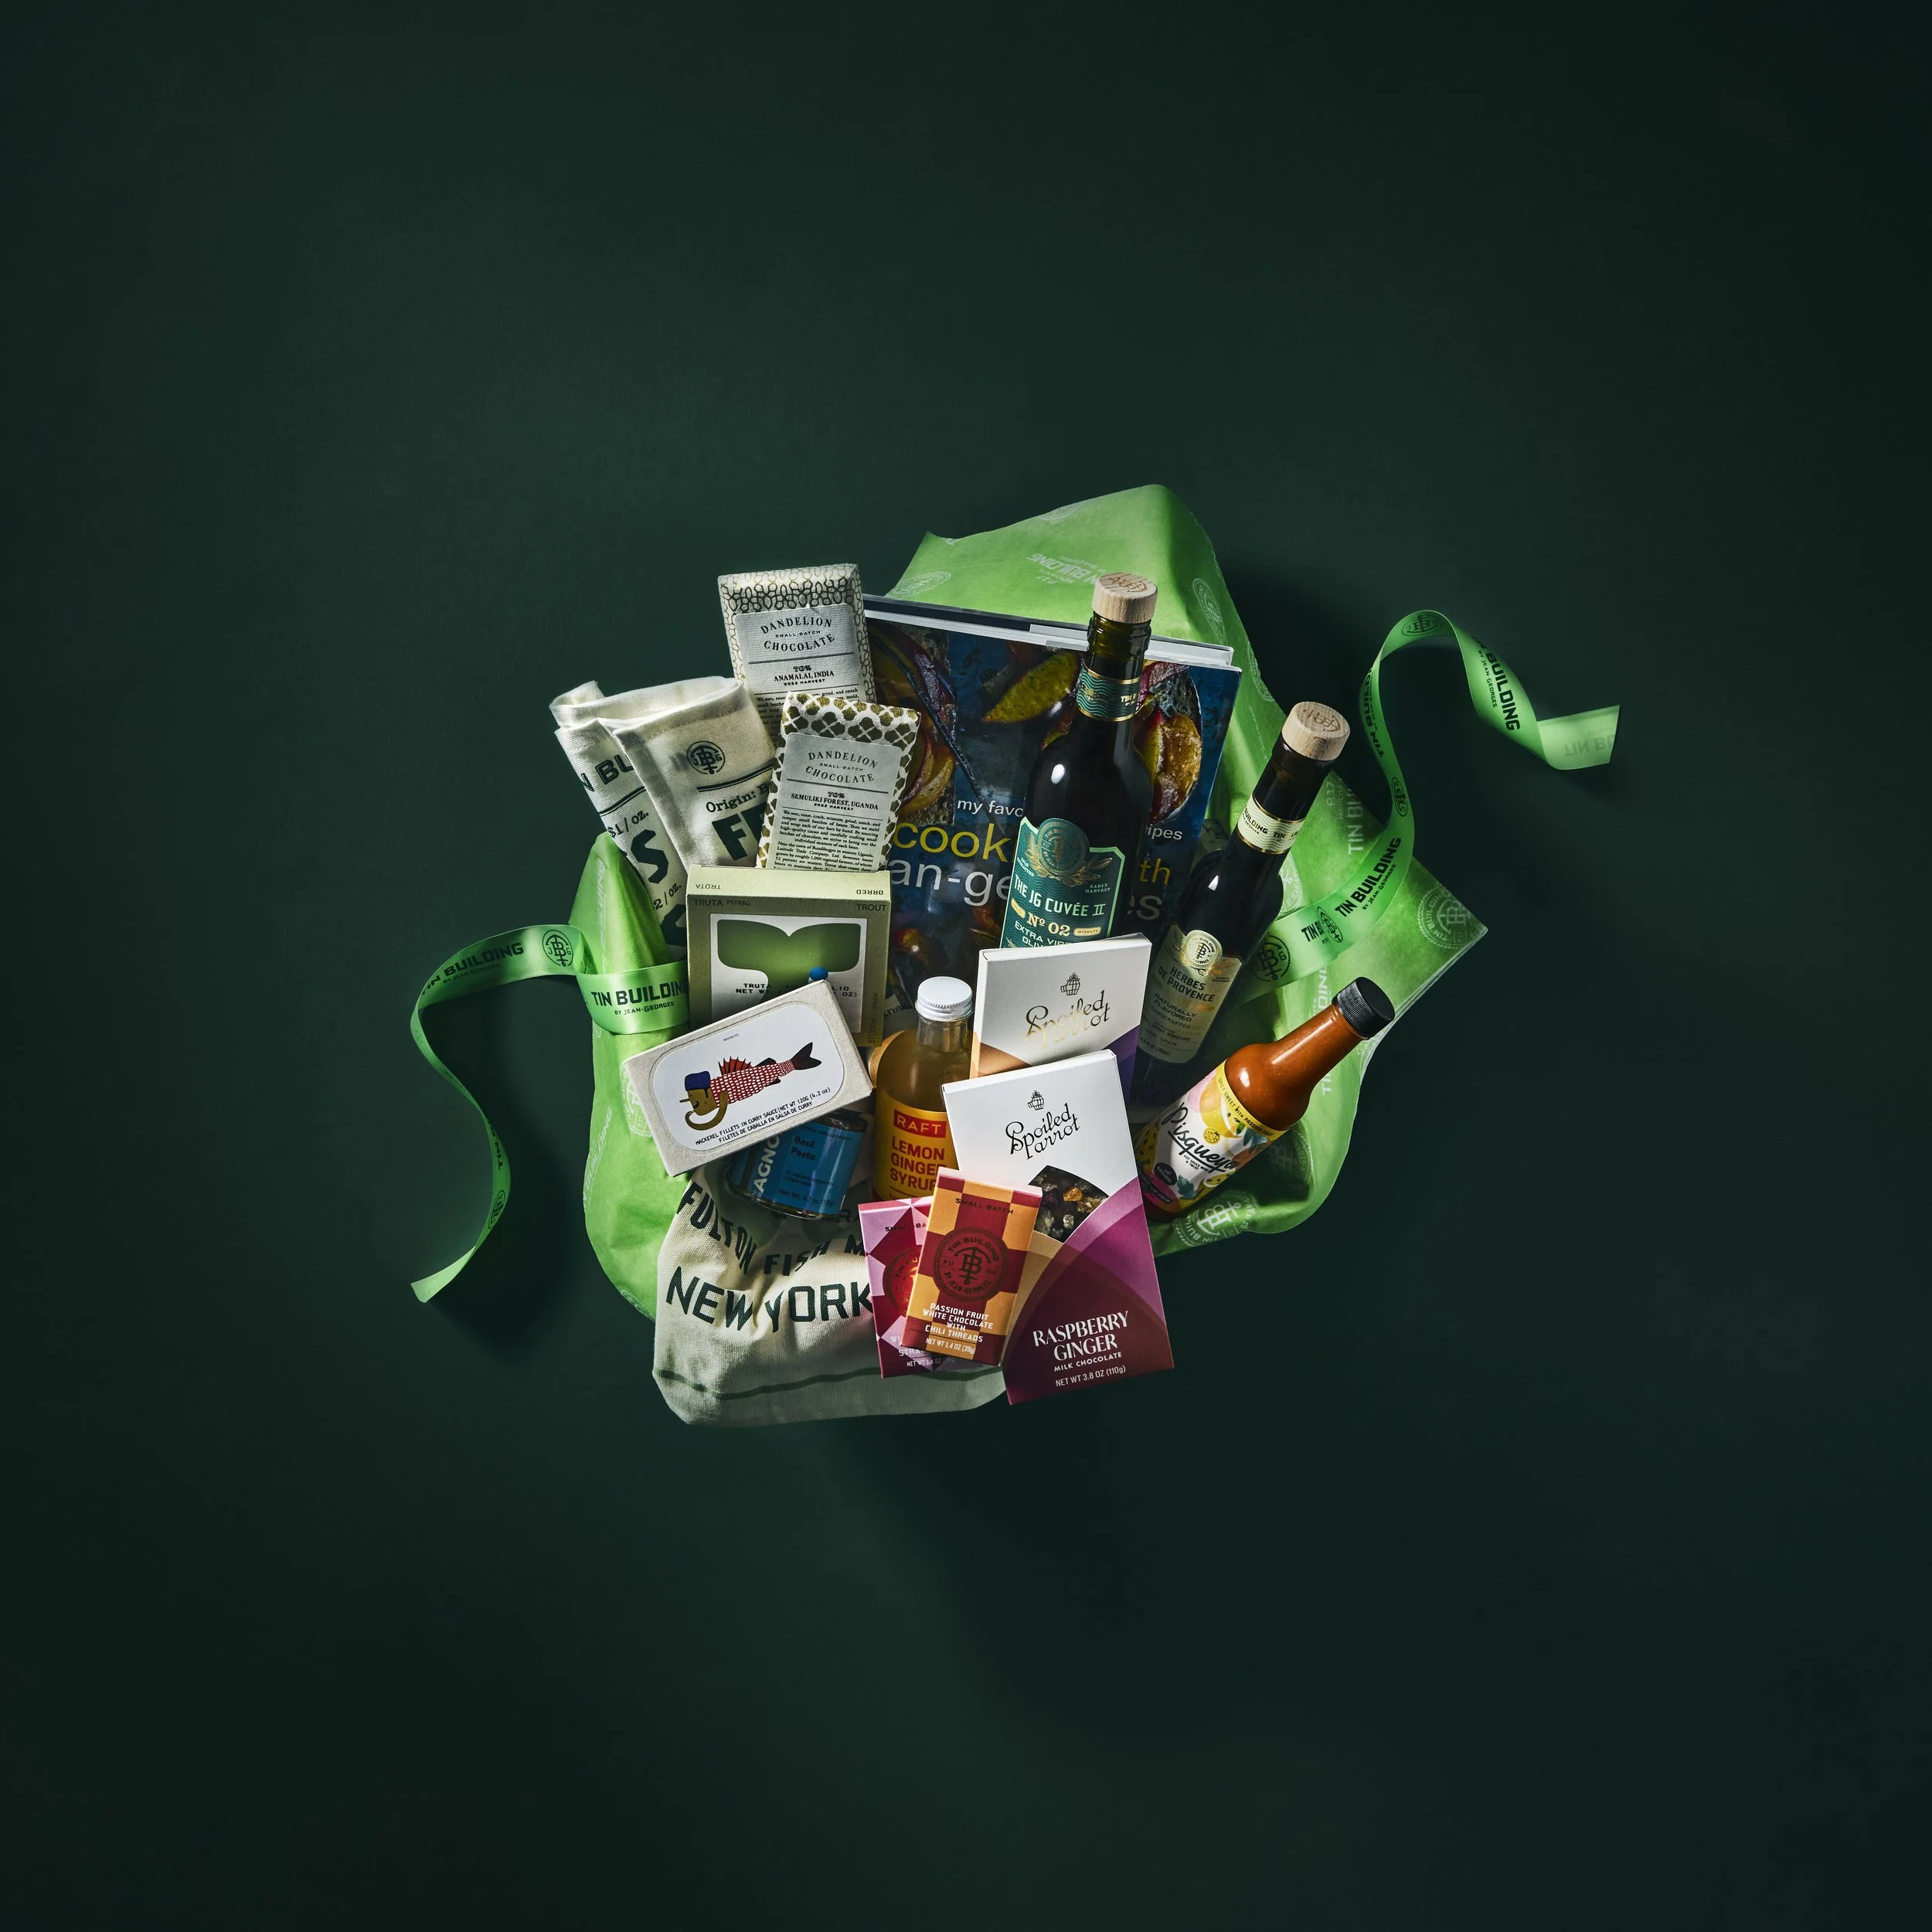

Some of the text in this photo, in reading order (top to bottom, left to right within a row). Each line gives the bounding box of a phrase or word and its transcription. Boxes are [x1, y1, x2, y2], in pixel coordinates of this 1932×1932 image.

[760, 617, 832, 634] DANDELION
[764, 634, 835, 651] CHOCOLATE
[1481, 660, 1498, 708] JEAN-GEORGES
[1485, 651, 1521, 731] BUILDING
[808, 751, 878, 768] DANDELION
[820, 763, 863, 771] SMALL-BATCH
[806, 767, 874, 783] CHOCOLATE
[706, 790, 757, 813] Origin:
[791, 794, 822, 802] SEMULIKI
[851, 801, 879, 810] UGANDA
[957, 801, 982, 815] my
[988, 801, 1024, 817] favo
[1347, 825, 1364, 855] TIN
[893, 822, 1171, 884] cook th
[889, 859, 1011, 906] an-ge
[1335, 900, 1358, 917] TIN
[1351, 837, 1401, 903] BUILDING
[1368, 865, 1396, 904] JEAN-GEORGES
[1014, 875, 1026, 897] THE
[1029, 891, 1042, 907] JG
[1046, 898, 1087, 916] CUVÉE
[1015, 921, 1043, 942] EXTRA
[1049, 923, 1070, 936] 02
[1301, 923, 1319, 942] TIN
[1022, 937, 1045, 947] OLIV
[444, 943, 524, 976] BUILDING
[1158, 968, 1166, 980] DE
[1168, 978, 1215, 1002] PROVENCE
[1171, 967, 1206, 991] HERBES
[591, 991, 612, 1007] TIN
[624, 1002, 674, 1015] JEAN-GEORGES
[1155, 993, 1197, 1017] NATURALLY
[1154, 1000, 1192, 1022] FLAVORED
[1224, 1091, 1236, 1107] SWEET
[1235, 1106, 1244, 1117] WITH
[696, 1133, 719, 1145] MACKEREL
[719, 1124, 740, 1136] FILLETS
[748, 1116, 762, 1124] CURRY
[798, 1097, 809, 1105] 120G
[719, 1132, 740, 1143] FILETES
[747, 1121, 768, 1131] CABALLA
[776, 1110, 791, 1119] SALSA
[798, 1101, 812, 1111] CURRY
[897, 1115, 941, 1134] RAFT
[1005, 1103, 1072, 1158] Spoiled
[794, 1136, 815, 1148] Basil
[893, 1136, 944, 1161] LEMON
[753, 1134, 781, 1194] AGNO
[791, 1147, 815, 1161] Pesto
[955, 1198, 1013, 1215] SMALL BATCH
[676, 1182, 832, 1276] FULTON FISH
[947, 1237, 999, 1261] TIN BUILDING
[665, 1266, 753, 1332] NEW
[765, 1281, 874, 1333] YORK
[923, 1308, 994, 1329] WHITE CHOCOLATE
[930, 1303, 989, 1321] PASSION FRUIT
[925, 1325, 983, 1342] CHILI THREADS
[947, 1321, 966, 1332] WITH
[1032, 1311, 1128, 1346] RASPBERRY
[962, 1345, 976, 1354] (39g)
[1054, 1333, 1117, 1361] GINGER
[1054, 1352, 1122, 1372] MILK CHOCOLATE
[1056, 1365, 1126, 1387] NET WT 3.8 OZ (110g)
